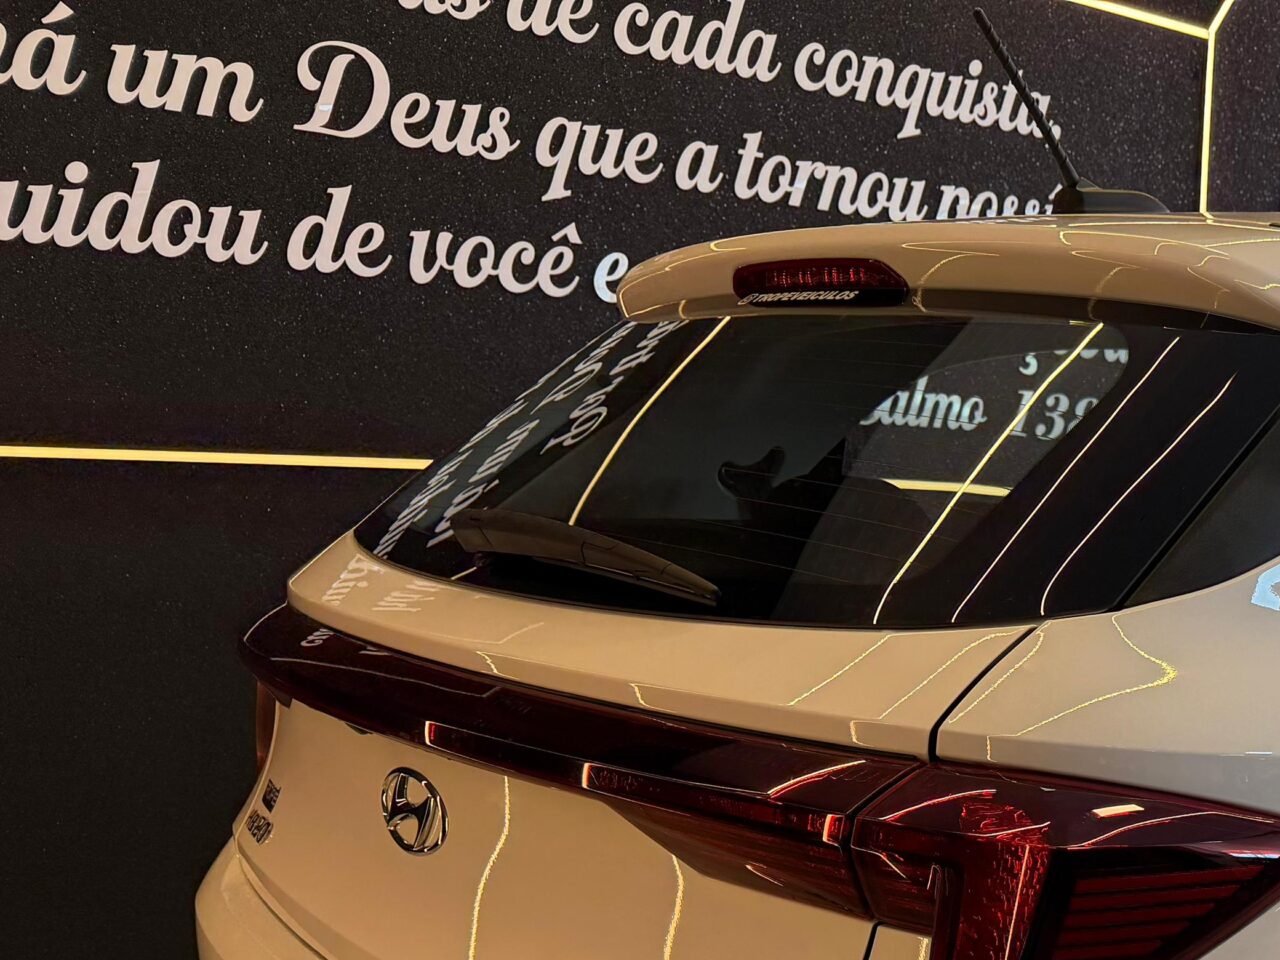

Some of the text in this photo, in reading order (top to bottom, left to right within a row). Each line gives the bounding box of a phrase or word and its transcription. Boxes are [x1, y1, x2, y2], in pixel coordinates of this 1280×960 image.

[613, 0, 782, 83] cada
[0, 1, 87, 95] á
[107, 43, 264, 122] um
[293, 40, 520, 160] Deus
[535, 116, 664, 201] que
[675, 141, 724, 193] a
[733, 131, 928, 222] tornou
[287, 185, 392, 277] de
[409, 223, 580, 297] você
[859, 375, 988, 431] almo
